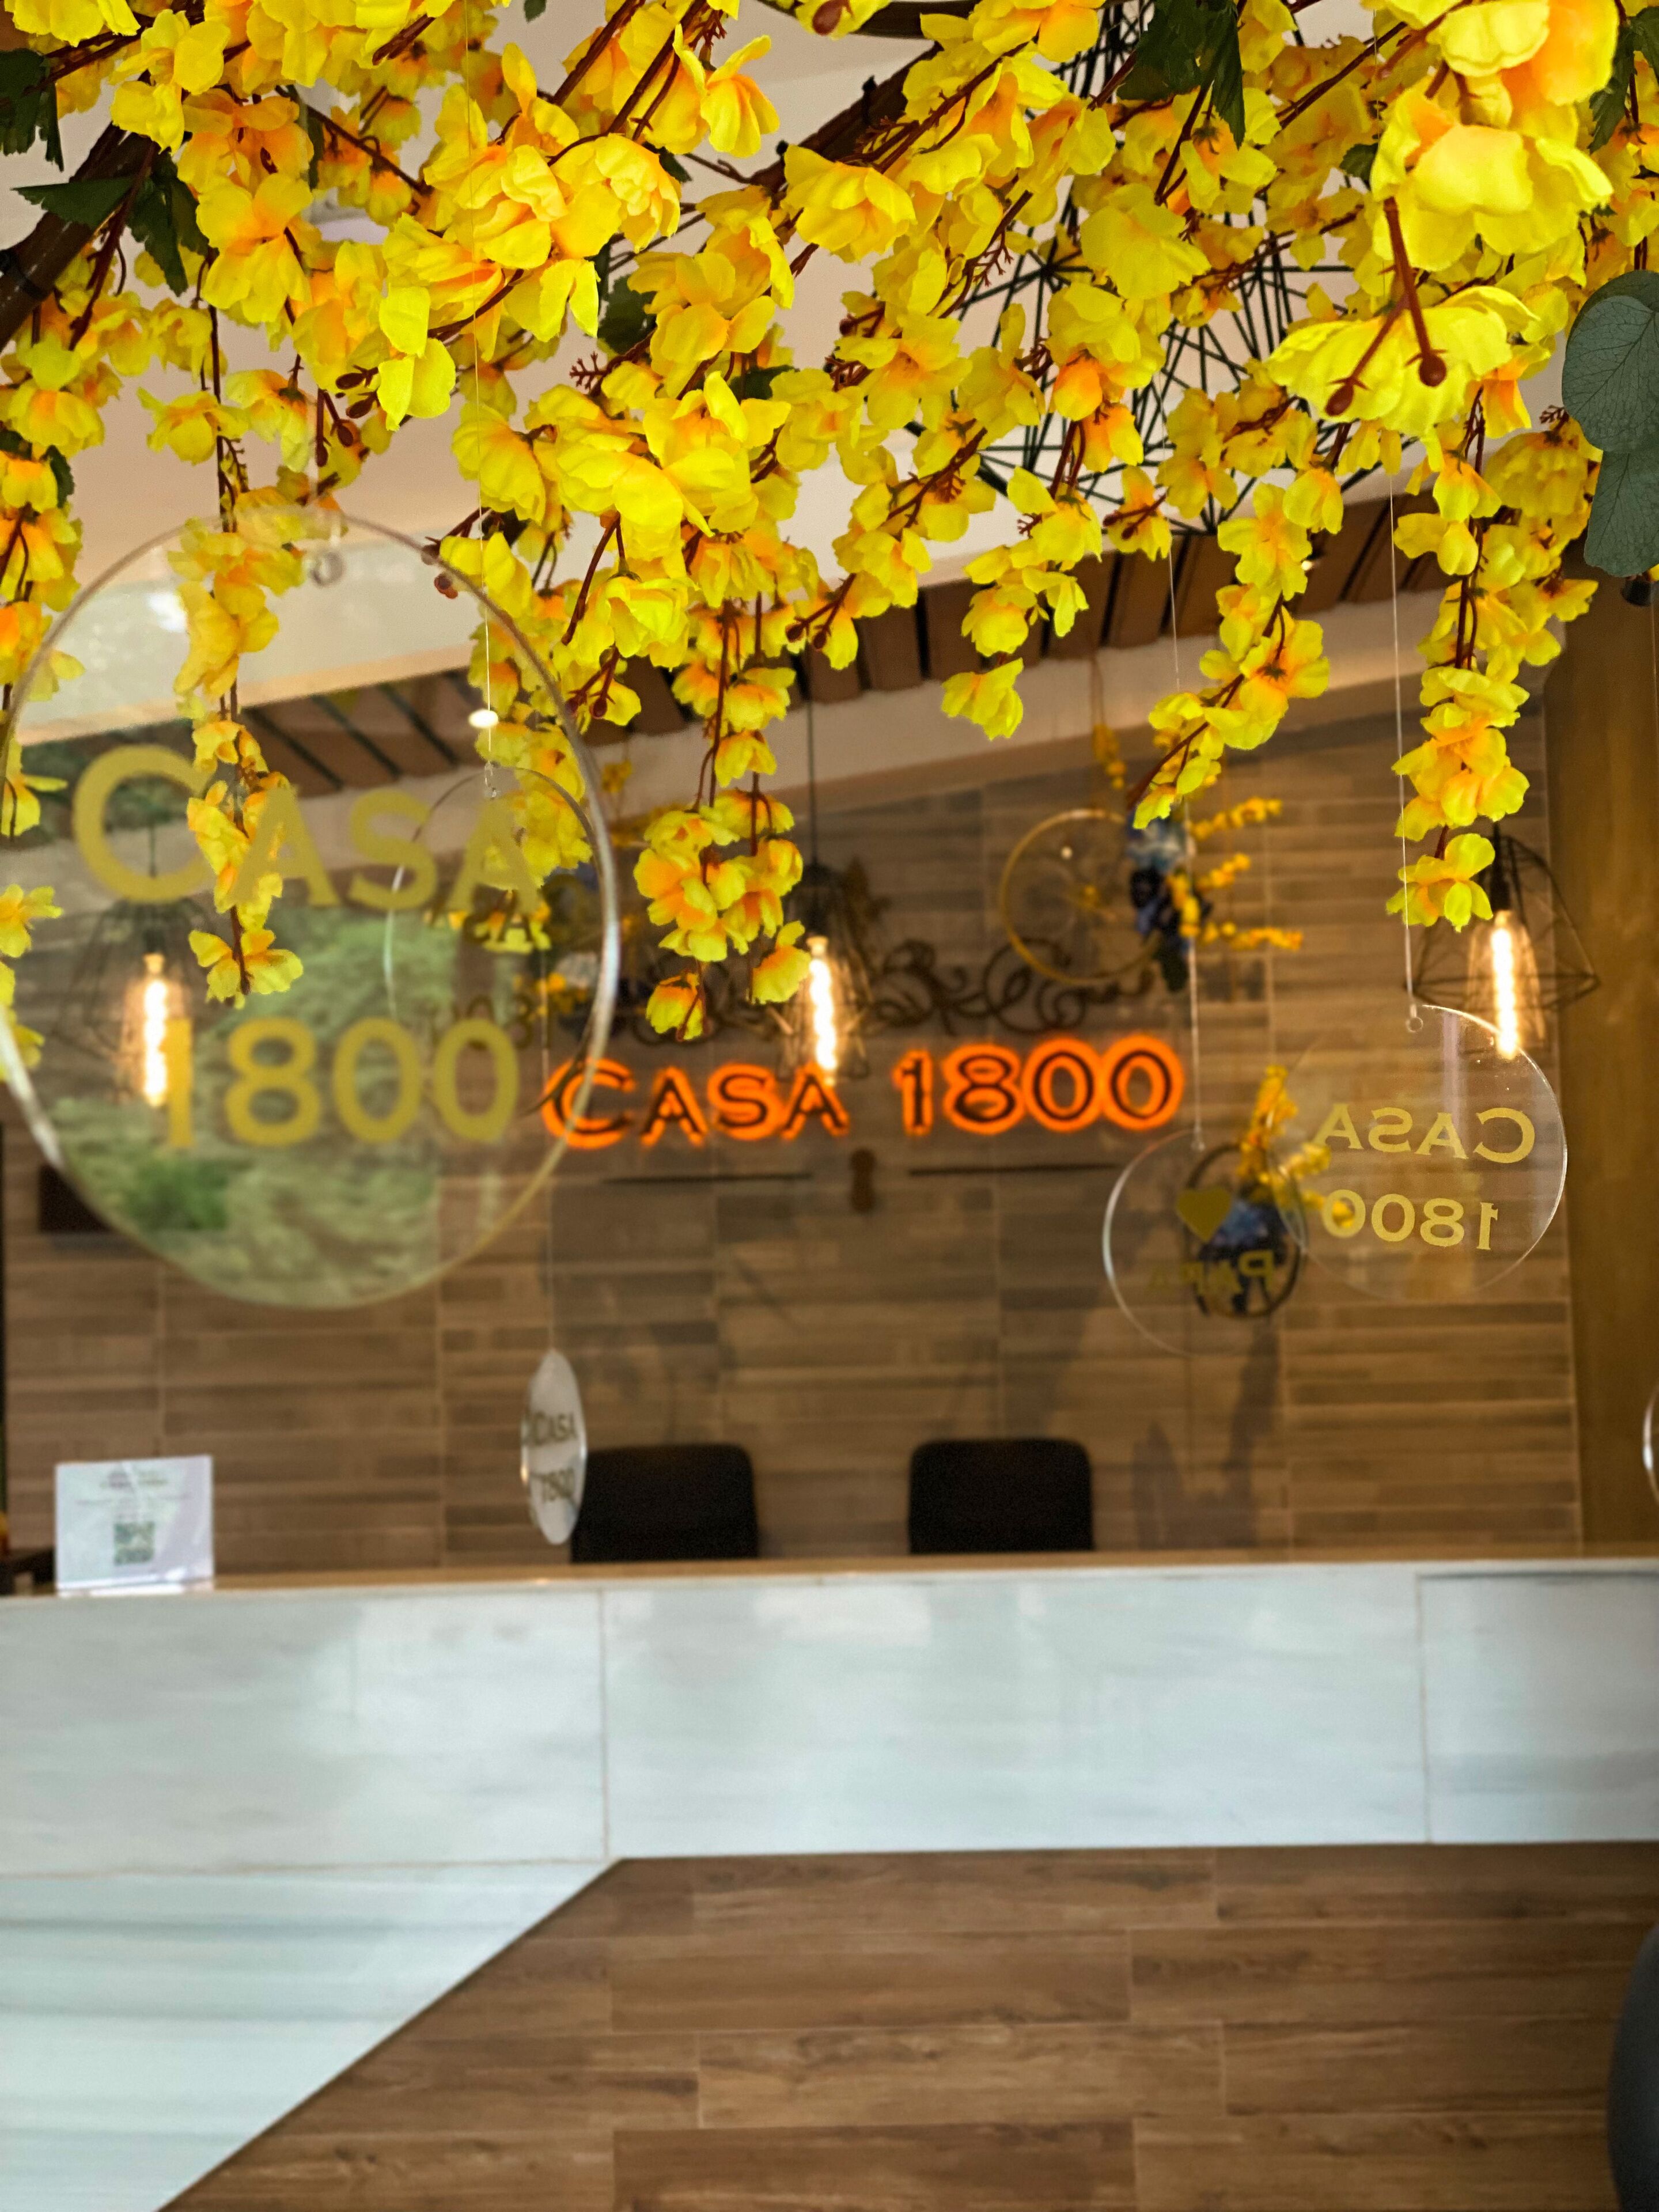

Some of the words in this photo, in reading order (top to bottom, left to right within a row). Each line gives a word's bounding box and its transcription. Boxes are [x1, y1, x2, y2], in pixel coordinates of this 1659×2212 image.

[73, 745, 544, 914] CASA
[164, 1017, 520, 1148] 1800
[540, 1058, 849, 1149] CASA
[892, 1033, 1185, 1134] 1800
